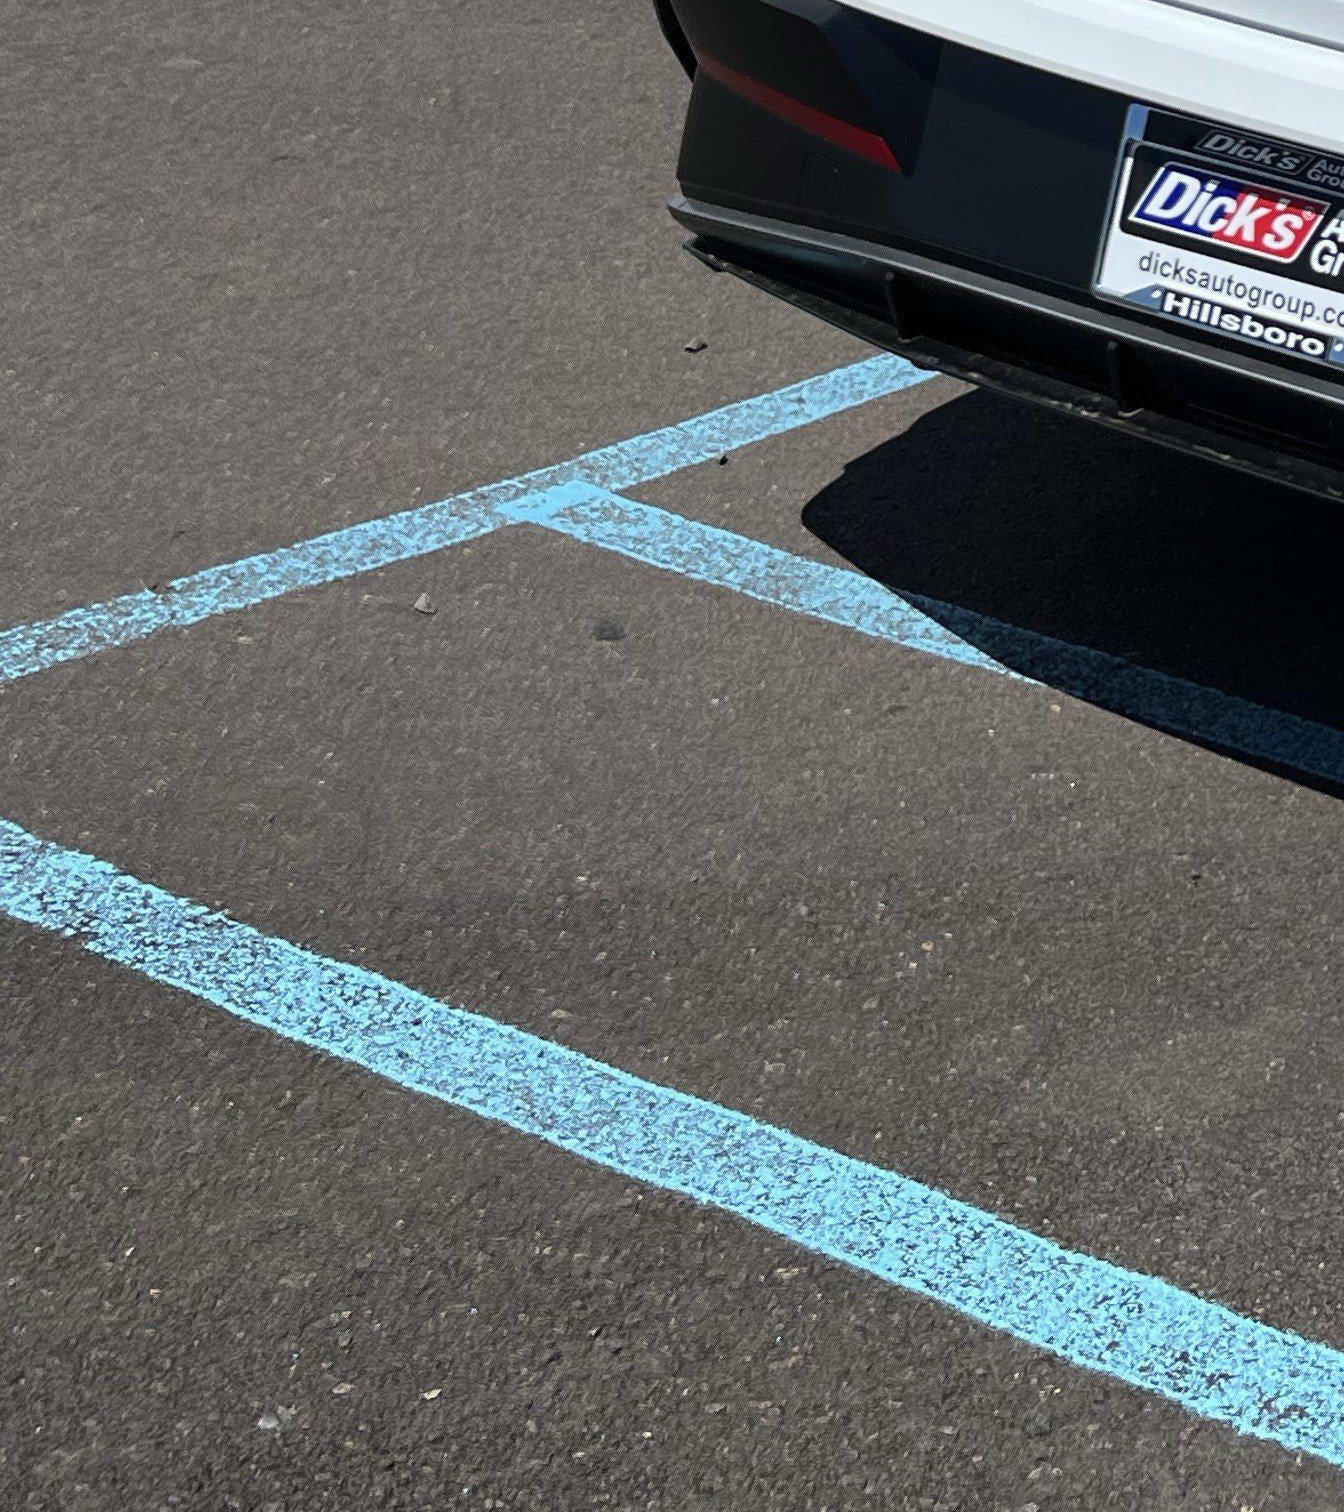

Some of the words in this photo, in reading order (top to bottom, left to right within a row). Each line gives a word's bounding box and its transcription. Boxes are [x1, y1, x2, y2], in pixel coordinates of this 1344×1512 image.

[1203, 134, 1299, 171] Dick's
[1144, 171, 1305, 252] Dick's
[1163, 290, 1326, 357] Hillsboro
